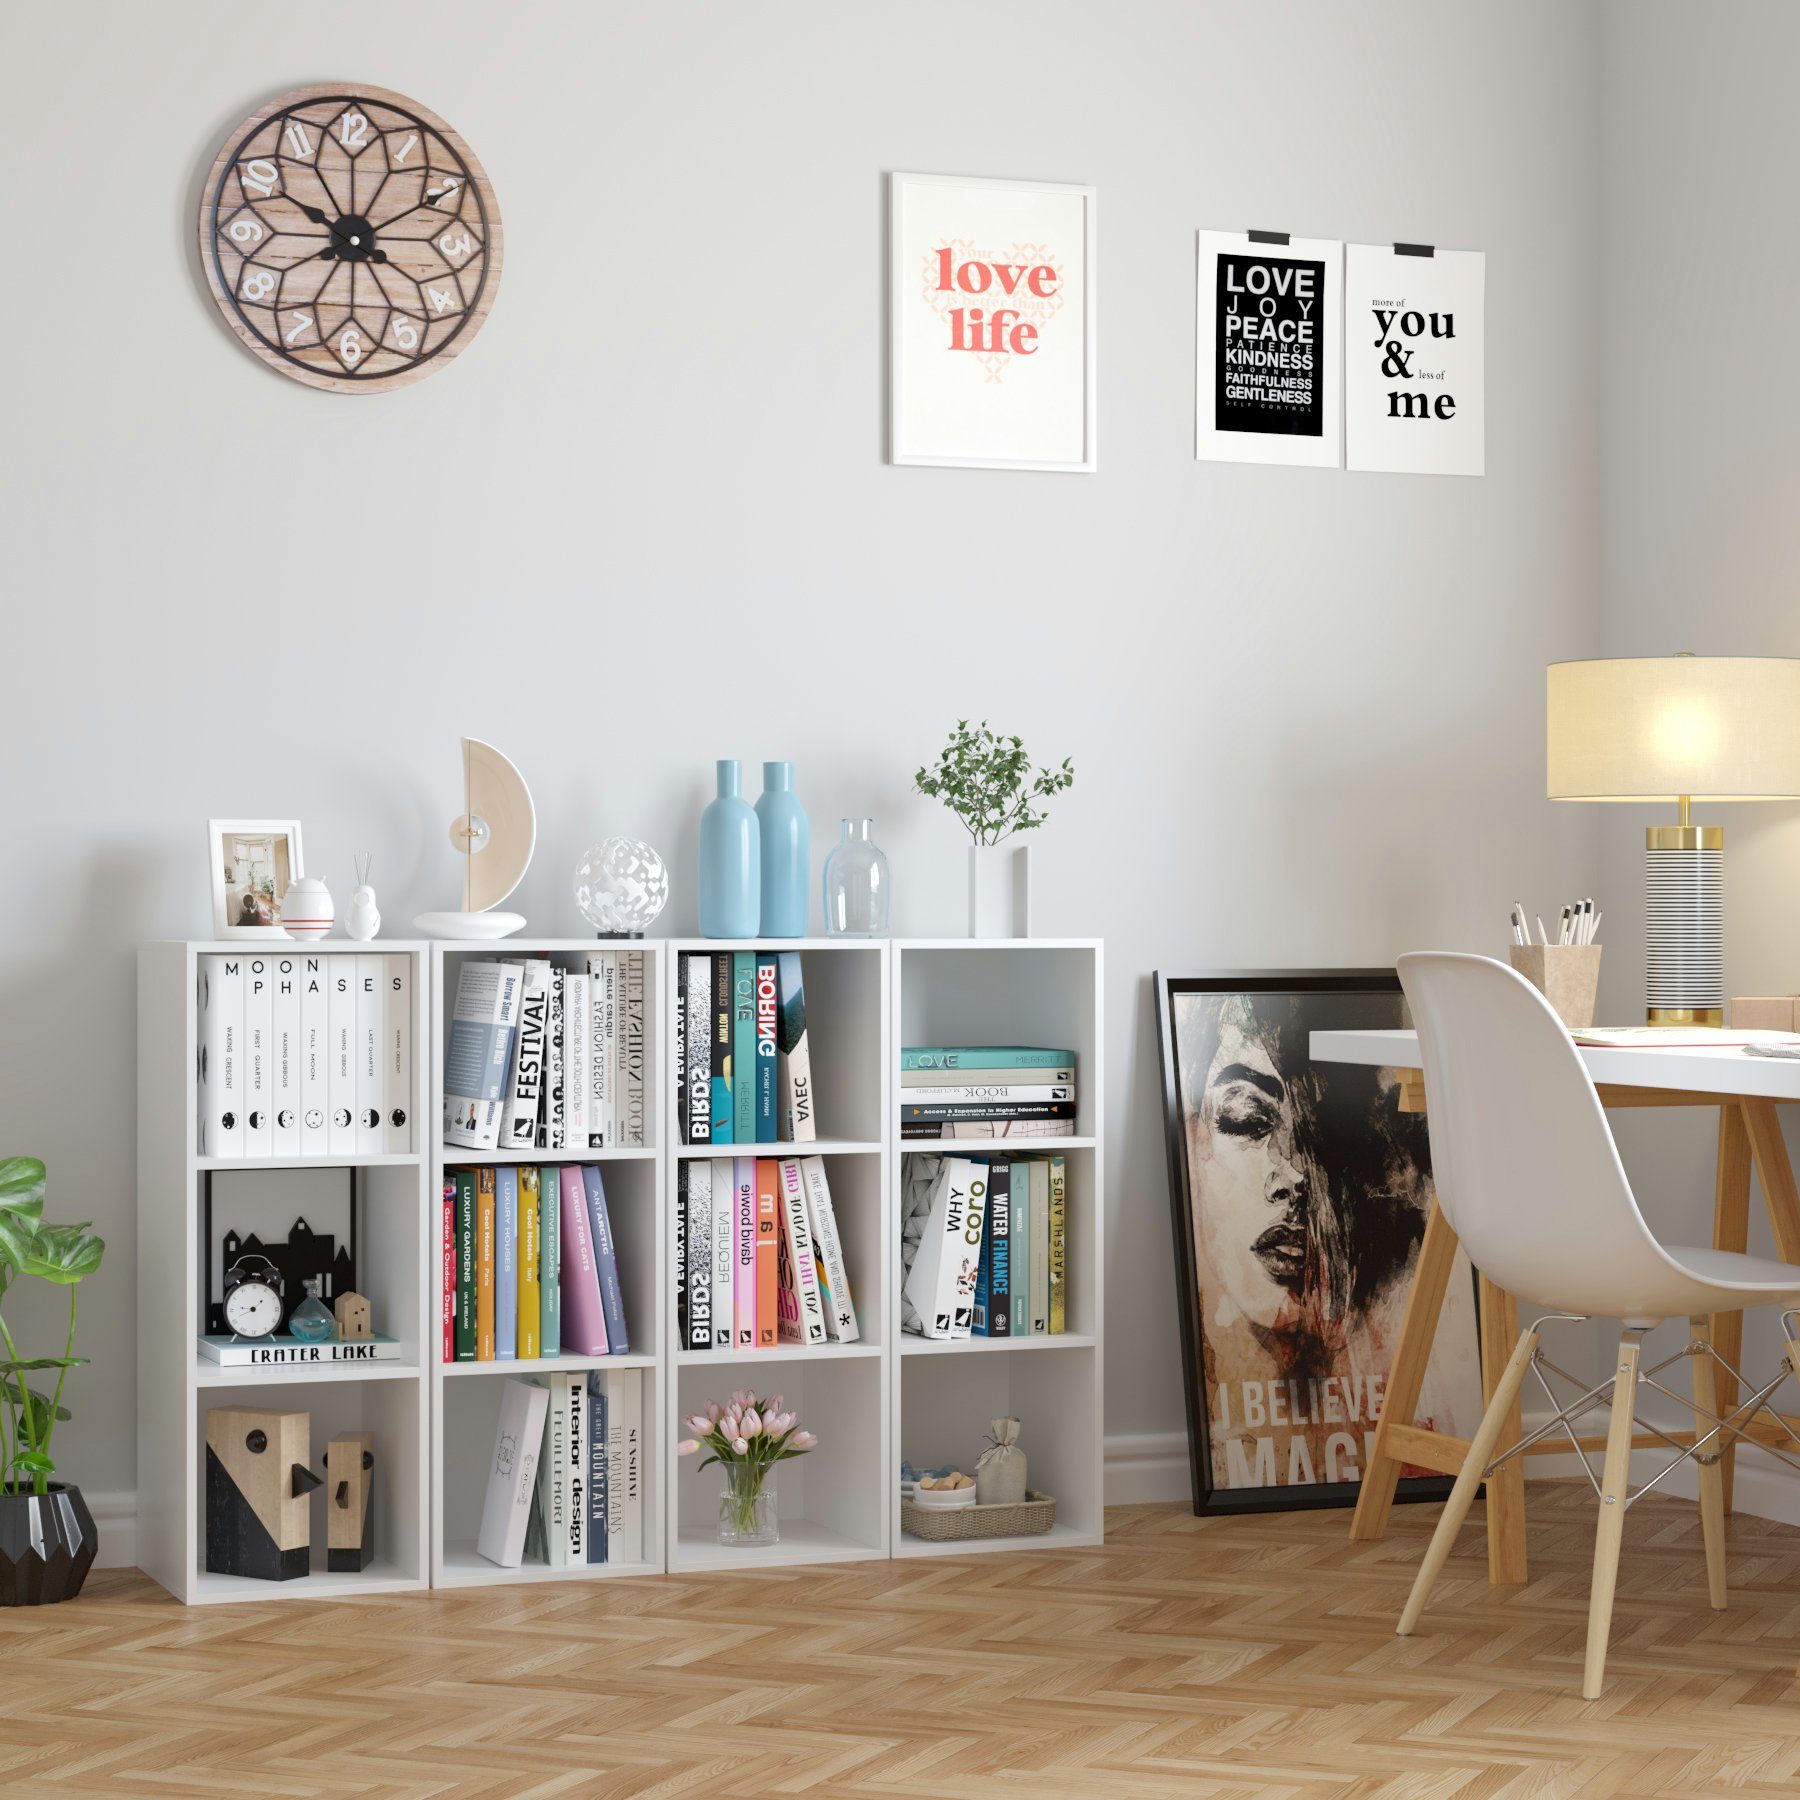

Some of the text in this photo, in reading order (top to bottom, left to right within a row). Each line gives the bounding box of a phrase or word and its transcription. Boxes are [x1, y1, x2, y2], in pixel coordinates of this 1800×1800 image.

[285, 124, 315, 159] 11
[339, 113, 369, 146] 12
[394, 135, 418, 163] 1
[241, 159, 279, 197] 10
[229, 220, 263, 242] 9
[439, 234, 471, 256] 3
[242, 272, 275, 300] 8
[935, 247, 1057, 298] love
[1226, 264, 1315, 297] LOVE
[427, 288, 455, 313] 4
[1372, 299, 1405, 307] more of
[286, 312, 314, 343] 7
[392, 316, 418, 349] 5
[948, 308, 1039, 355] life
[1226, 315, 1313, 344] PEACE
[1372, 310, 1456, 348] you
[339, 331, 361, 362] 6
[1226, 338, 1313, 354] PATIENCE
[1226, 348, 1313, 370] KINDNESS
[1381, 340, 1414, 379] &
[1226, 365, 1313, 378] GOODNESS
[1226, 372, 1312, 390] FAITHFULNESS
[1419, 369, 1445, 380] less of
[1226, 385, 1312, 404] GENTLENESS
[1387, 392, 1456, 420] me
[225, 959, 319, 975] MOON
[254, 978, 402, 994] PHASES
[499, 977, 516, 1021] Borrow Smart
[517, 991, 545, 1100] FESTIVAL
[907, 1054, 959, 1068] LOVE
[965, 1087, 1008, 1097] BOOK
[592, 1190, 609, 1255] ANTARCTIC
[947, 1187, 964, 1232] WHY
[965, 1180, 986, 1245] coro
[571, 1186, 590, 1272] LUXURY FOR CATS
[993, 1193, 1008, 1295] WATER FINANCE
[1054, 1178, 1063, 1278] MARSHLANDS
[464, 1291, 468, 1300] UK
[251, 1345, 377, 1363] CRATER LAKE
[1219, 1375, 1384, 1430] I BELIEVE
[554, 1410, 563, 1526] FEUILLEMORT
[570, 1385, 584, 1554] Interior design
[592, 1442, 604, 1519] MOUNTAIN
[610, 1426, 623, 1534] THE MOUNTAINS
[629, 1428, 637, 1501] SUNSHINE
